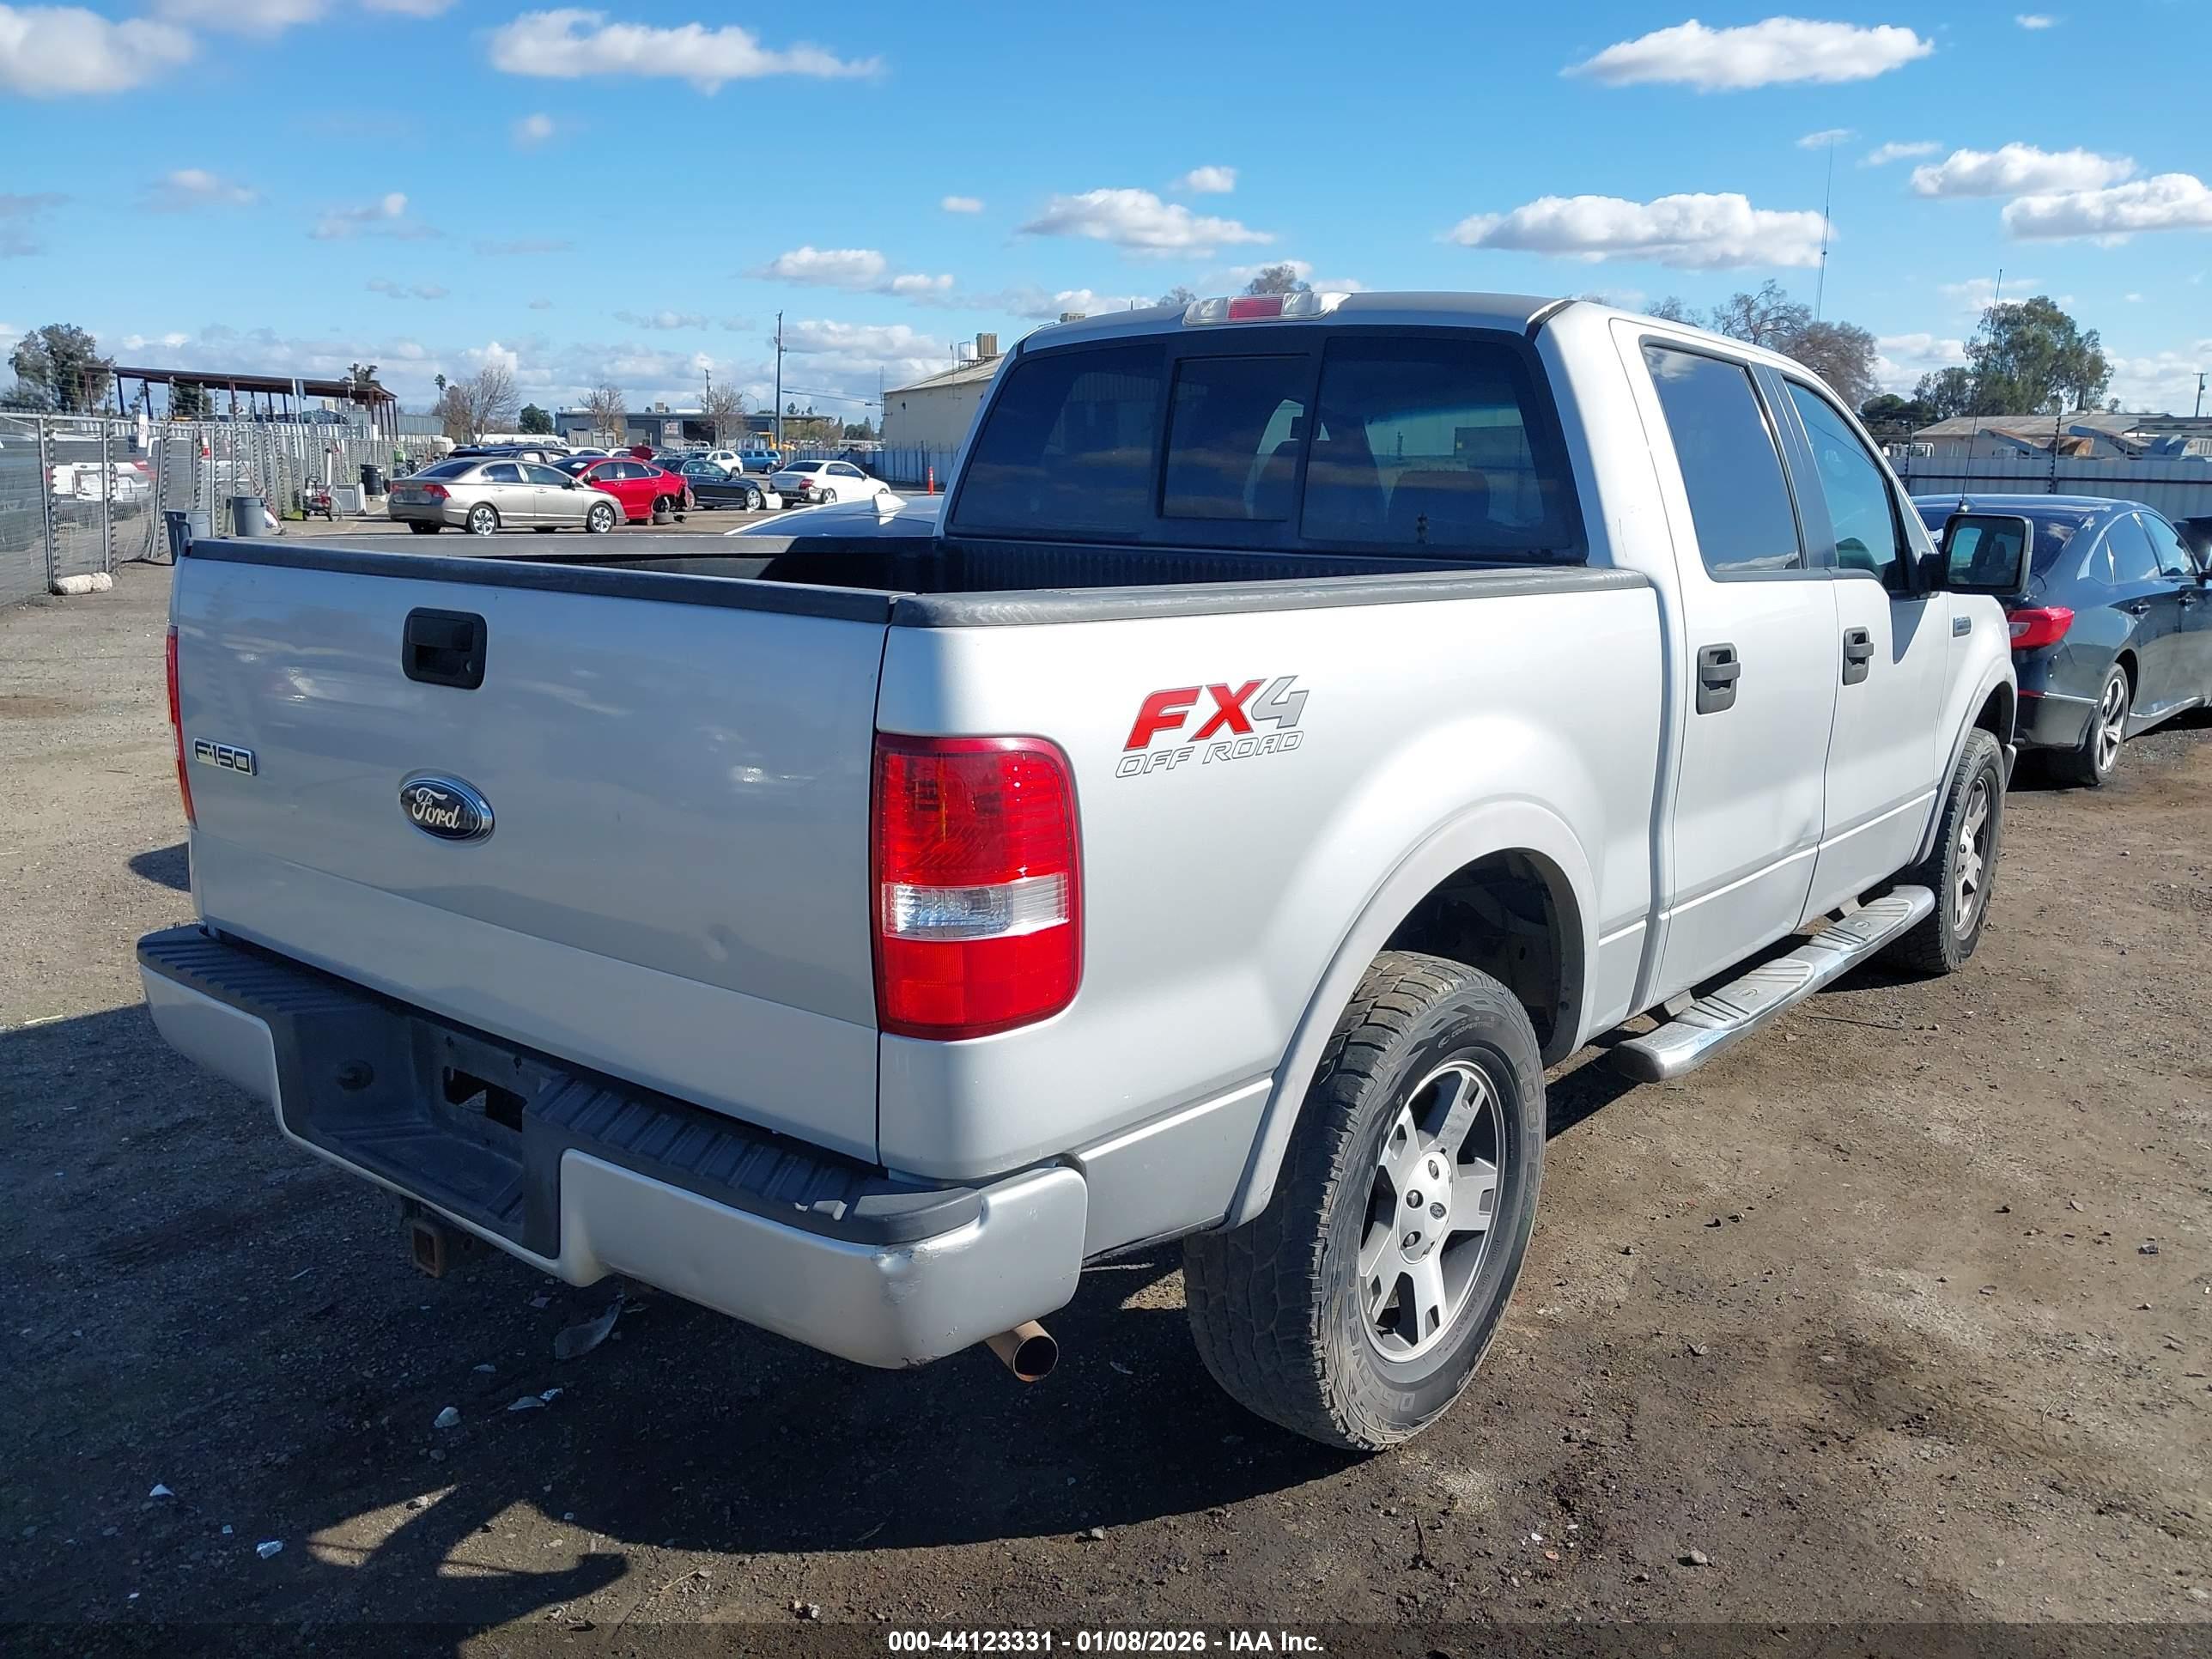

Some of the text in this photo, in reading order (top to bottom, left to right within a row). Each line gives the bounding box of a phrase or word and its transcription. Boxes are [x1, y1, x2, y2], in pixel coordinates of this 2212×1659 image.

[1123, 675, 1310, 752] FX4
[194, 738, 252, 775] F-150
[1115, 731, 1304, 779] OFF ROAD
[412, 787, 460, 830] Ford
